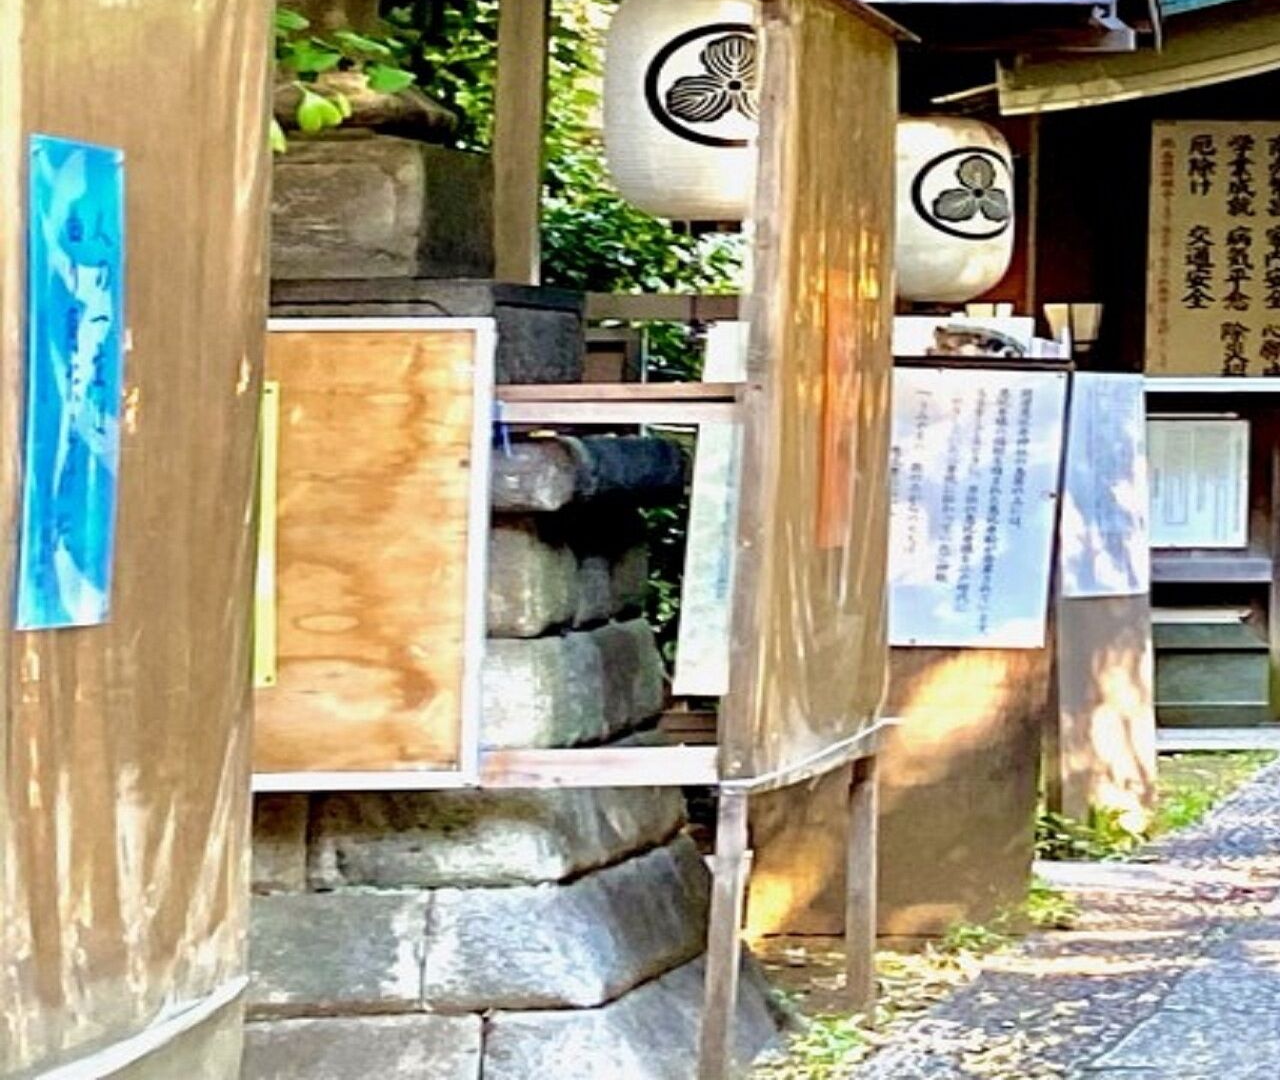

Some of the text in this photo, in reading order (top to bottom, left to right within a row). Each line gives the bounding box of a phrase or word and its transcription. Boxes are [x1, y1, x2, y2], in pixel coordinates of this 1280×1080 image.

[1181, 133, 1217, 309] 厄除け 交通安全
[1226, 133, 1256, 217] 学業成就
